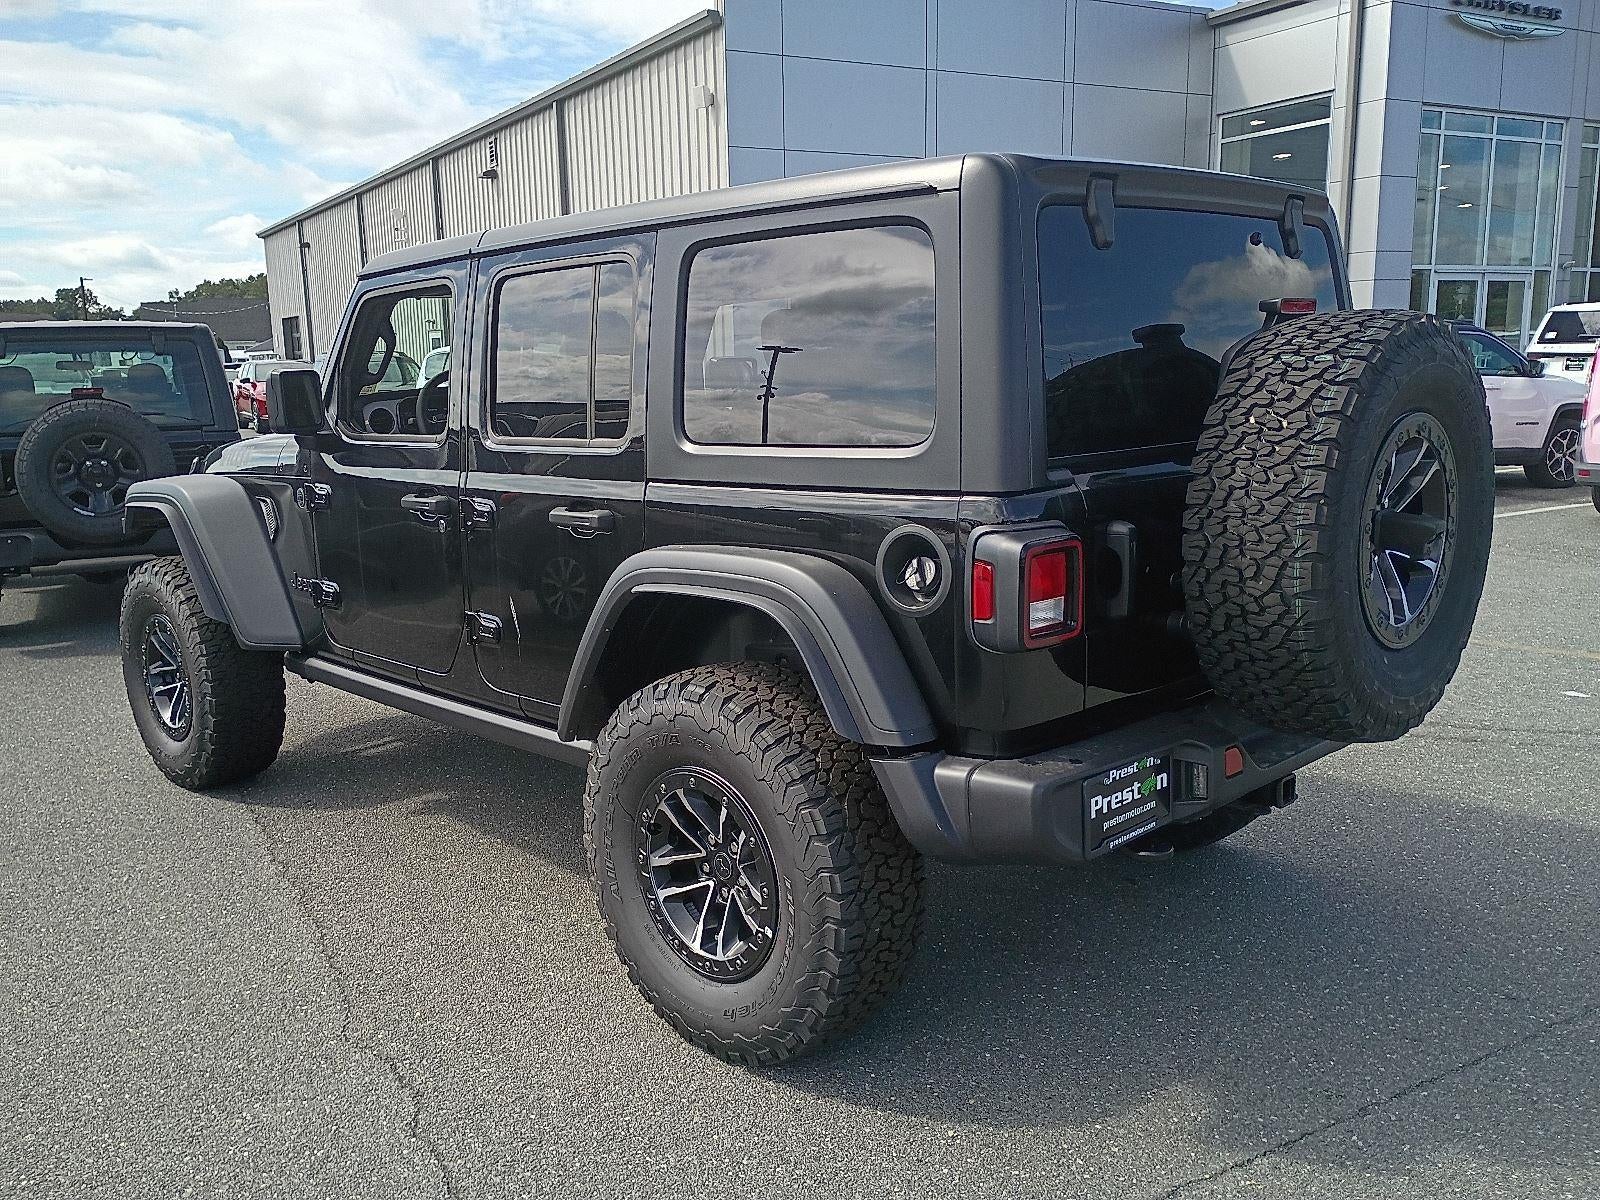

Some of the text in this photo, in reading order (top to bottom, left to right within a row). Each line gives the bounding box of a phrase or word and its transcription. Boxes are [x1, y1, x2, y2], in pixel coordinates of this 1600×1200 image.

[1090, 772, 1167, 820] Preston
[1103, 800, 1156, 832] prestonmotor.com
[1109, 821, 1156, 849] prestonmotor.com
